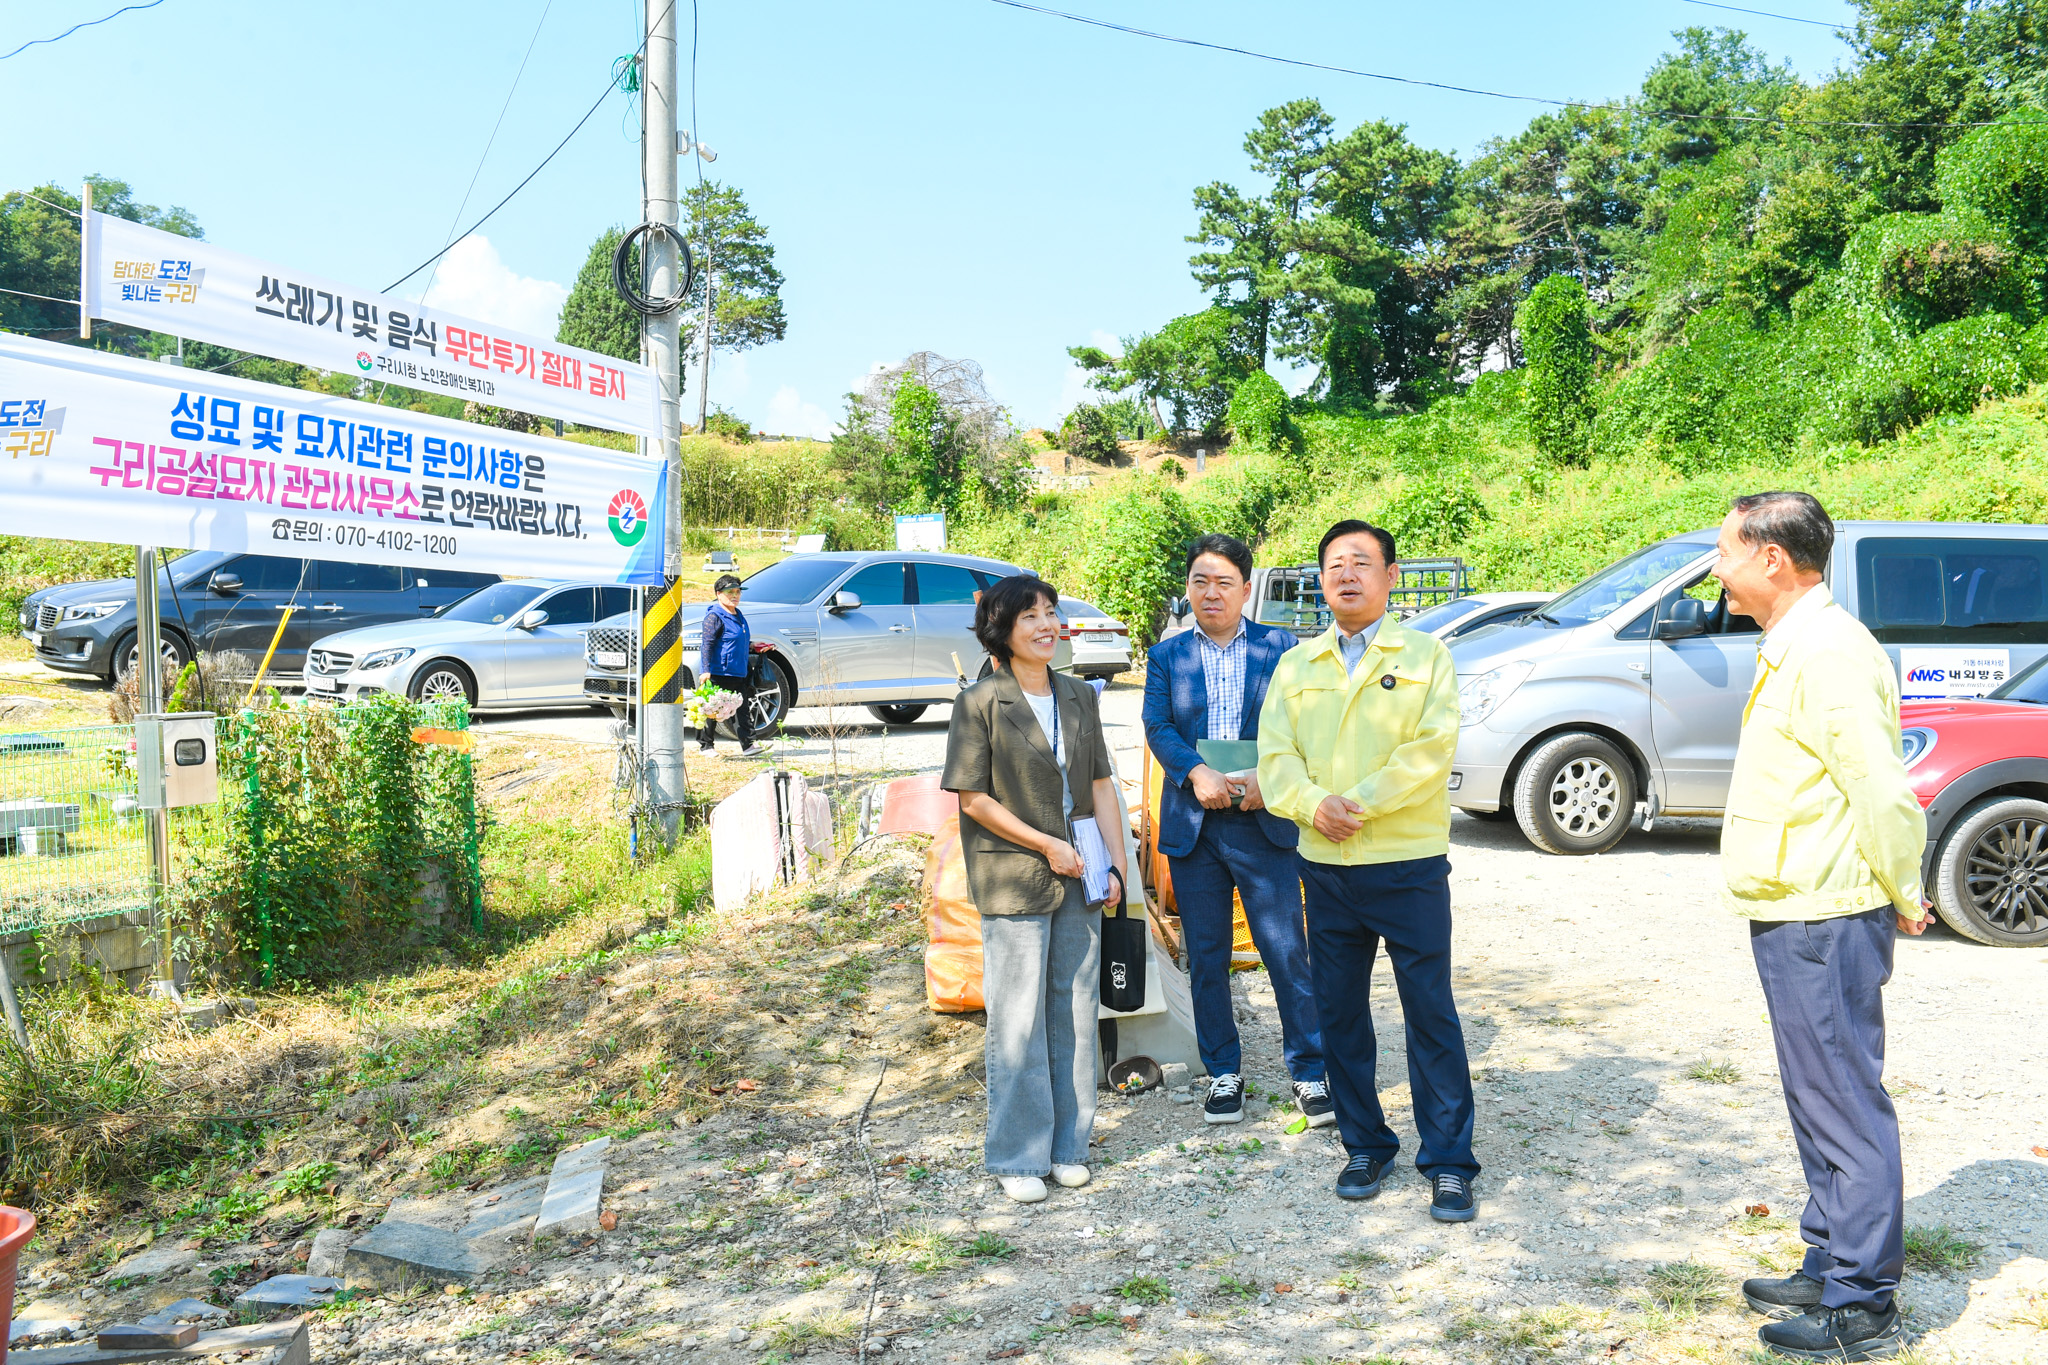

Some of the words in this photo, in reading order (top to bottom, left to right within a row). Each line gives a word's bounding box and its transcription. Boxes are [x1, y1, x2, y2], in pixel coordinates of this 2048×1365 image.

[113, 261, 156, 280] 담대한
[157, 259, 192, 282] 도전
[121, 284, 162, 303] 빛나는
[164, 283, 198, 304] 구리
[255, 275, 343, 333] 쓰레기
[352, 300, 379, 343] 및
[387, 310, 438, 357] 음식
[444, 325, 536, 380] 무단투기
[541, 350, 582, 391] 절대
[588, 362, 626, 401] 금지
[376, 355, 417, 380] 구리시청
[420, 364, 496, 397] 노인장애인복지과
[0, 399, 47, 428] 도전
[5, 430, 55, 458] 구리
[170, 392, 241, 446] 성묘
[252, 405, 285, 454] 및
[294, 413, 413, 475] 묘지관련
[422, 437, 546, 494] 문의사항은
[89, 436, 276, 505] 구리공설묘지
[281, 464, 445, 524] 관리사무소로
[450, 488, 588, 541] 연락바랍니다.
[292, 520, 323, 543] 문의
[335, 525, 458, 556] 070-4102-1200
[1909, 669, 1945, 682] NWS
[1949, 670, 2004, 680] 내외방송
